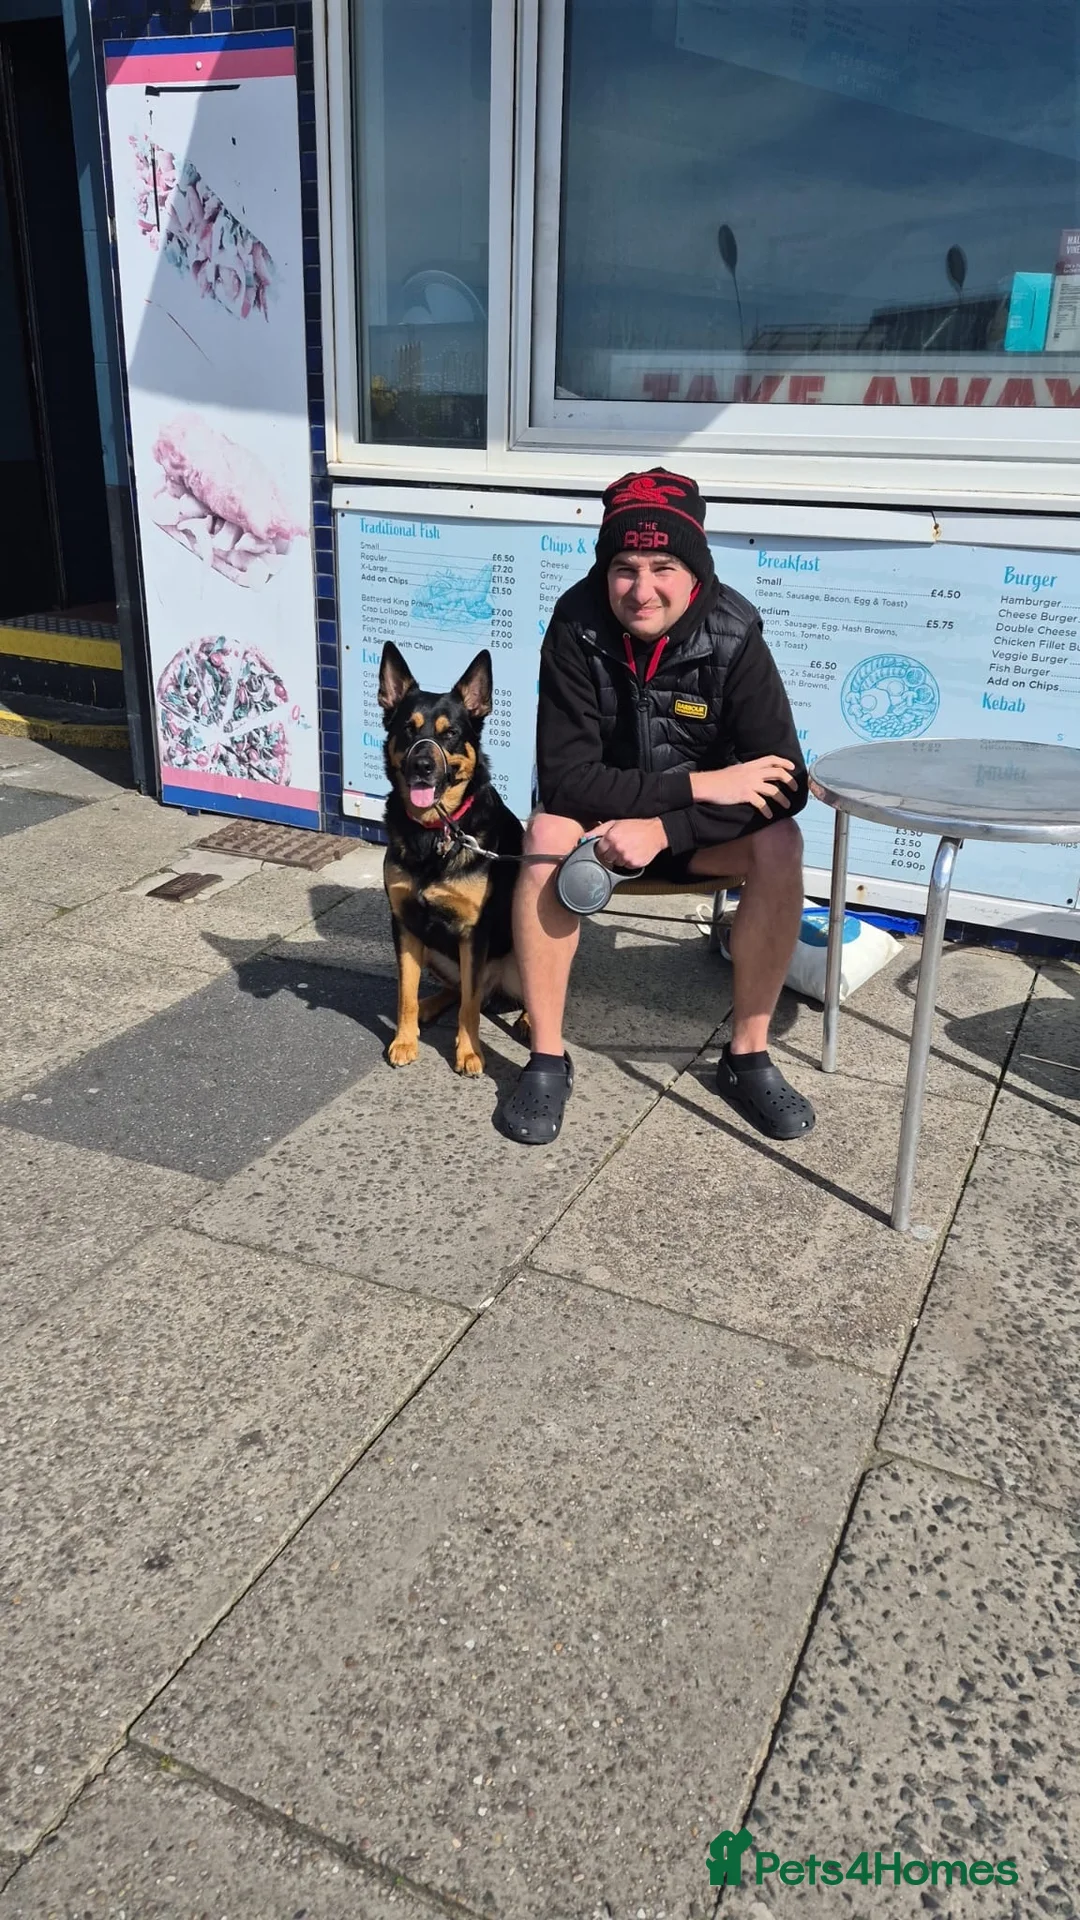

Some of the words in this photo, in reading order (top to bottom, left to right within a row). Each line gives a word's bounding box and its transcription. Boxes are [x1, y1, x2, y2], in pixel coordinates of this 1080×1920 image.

[360, 517, 416, 537] Traditional
[420, 521, 440, 539] Fish
[637, 521, 658, 531] THE
[541, 534, 573, 555] Chips
[577, 537, 587, 554] &
[624, 530, 669, 549] ASP
[360, 541, 380, 550] Small
[492, 553, 515, 563] £6.50
[360, 552, 387, 561] Regular
[492, 564, 514, 574] £7.20
[540, 560, 569, 570] Cheese
[758, 547, 820, 572] Breakfast
[360, 563, 388, 573] X-Large
[492, 575, 516, 585] £11.50
[540, 571, 563, 581] Gravy
[1004, 565, 1058, 592] Burger
[361, 573, 376, 582] Add
[388, 575, 409, 585] Chips
[491, 586, 512, 596] £1.50
[540, 582, 561, 592] Curry
[756, 576, 782, 585] Small
[930, 589, 961, 599] £4.50
[361, 593, 392, 604] Battered
[393, 597, 409, 607] King
[491, 608, 513, 618] £7.00
[854, 596, 870, 606] Egg
[873, 598, 879, 606] &
[882, 599, 908, 608] Toast)
[1000, 595, 1062, 608] Hamburger
[379, 606, 408, 617] Lollipop
[491, 619, 513, 629] £7.00
[998, 608, 1037, 620] Cheese
[1040, 611, 1078, 624] Burger
[361, 614, 388, 625] Scampi
[491, 629, 513, 639] £7.00
[842, 624, 862, 632] Hash
[864, 626, 898, 636] Browns,
[926, 620, 954, 629] £5.75
[995, 622, 1034, 634] Double
[1037, 625, 1077, 637] Cheese
[362, 624, 377, 633] Fish
[377, 626, 396, 635] Cake
[490, 640, 513, 650] £5.00
[993, 636, 1036, 648] Chicken
[1038, 640, 1066, 651] Fillet
[397, 640, 413, 649] with
[413, 642, 434, 652] Chips
[784, 641, 808, 650] Toast)
[991, 649, 1028, 661] Veggie
[1031, 653, 1068, 665] Burger
[810, 661, 837, 670] £6.50
[988, 663, 1011, 673] Fish
[1013, 665, 1050, 677] Burger
[986, 676, 1009, 686] Add
[1011, 680, 1026, 688] on
[1029, 680, 1059, 692] Chips
[494, 688, 512, 697] 0.90
[494, 698, 512, 708] 0.90
[982, 691, 1026, 713] Kebab
[493, 709, 512, 718] 0.90
[489, 718, 511, 727] £0.90
[489, 728, 511, 737] £0.90
[488, 738, 511, 747] £0.90
[894, 838, 922, 848] £3.50
[892, 848, 921, 859] £3.00
[891, 859, 926, 871] £0.90p
